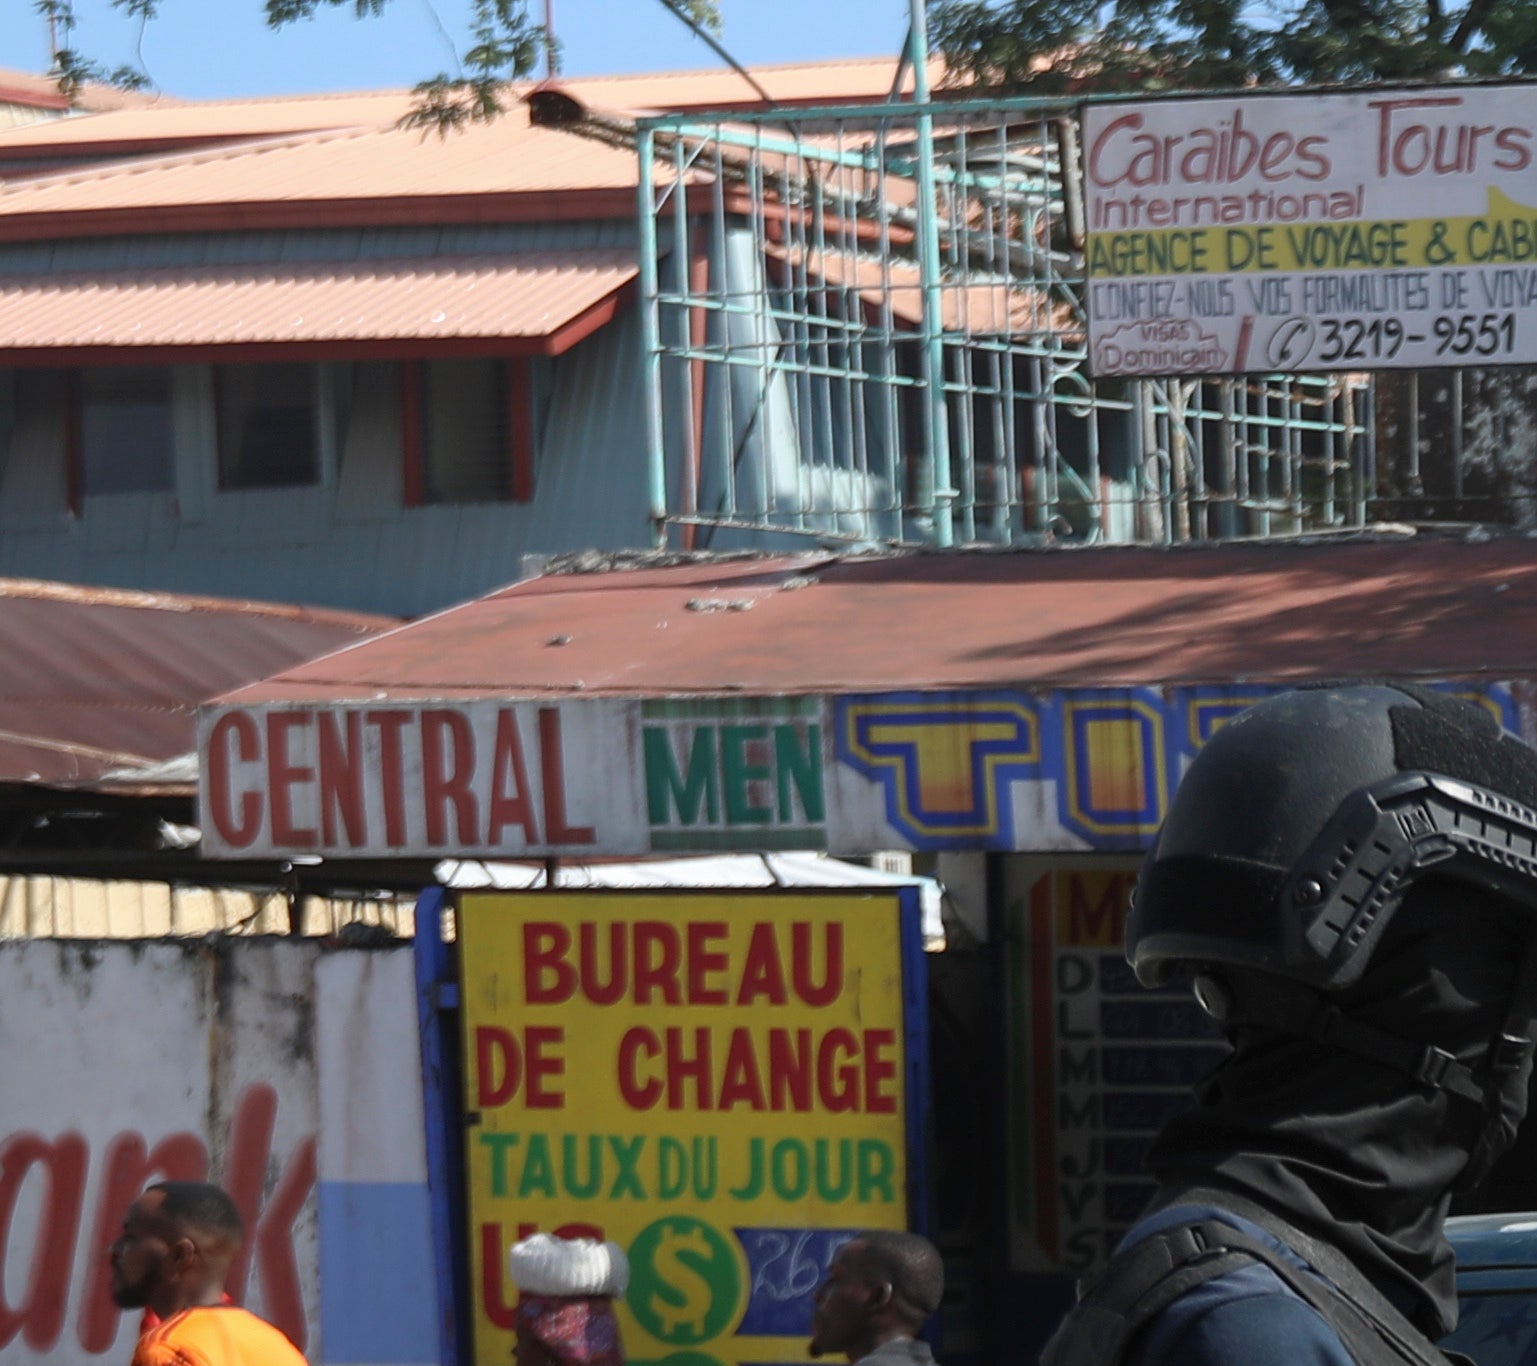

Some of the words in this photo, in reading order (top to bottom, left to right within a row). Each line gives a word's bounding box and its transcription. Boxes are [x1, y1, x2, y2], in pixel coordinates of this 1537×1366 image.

[1088, 107, 1333, 190] Caraïbes
[1368, 97, 1534, 178] Tours
[1090, 230, 1208, 274] AGENCE
[1227, 228, 1279, 272] DE
[1286, 220, 1410, 267] VOYAGE
[1425, 220, 1457, 265] &
[1092, 184, 1364, 230] International
[1093, 277, 1235, 321] CONFIEZ-NOUS
[1246, 276, 1293, 316] VOS
[1442, 269, 1469, 310] DE
[1319, 314, 1517, 362] 3219-9551
[206, 705, 597, 850] CENTRAL
[641, 723, 825, 828] MEN
[521, 919, 846, 1008] BUREAU
[474, 1024, 567, 1111] DE
[616, 1024, 899, 1115] CHANGE
[478, 1131, 649, 1201] TAUX
[656, 1134, 720, 1201] DU
[727, 1135, 897, 1204] JOUR
[0, 1082, 319, 1356] ank
